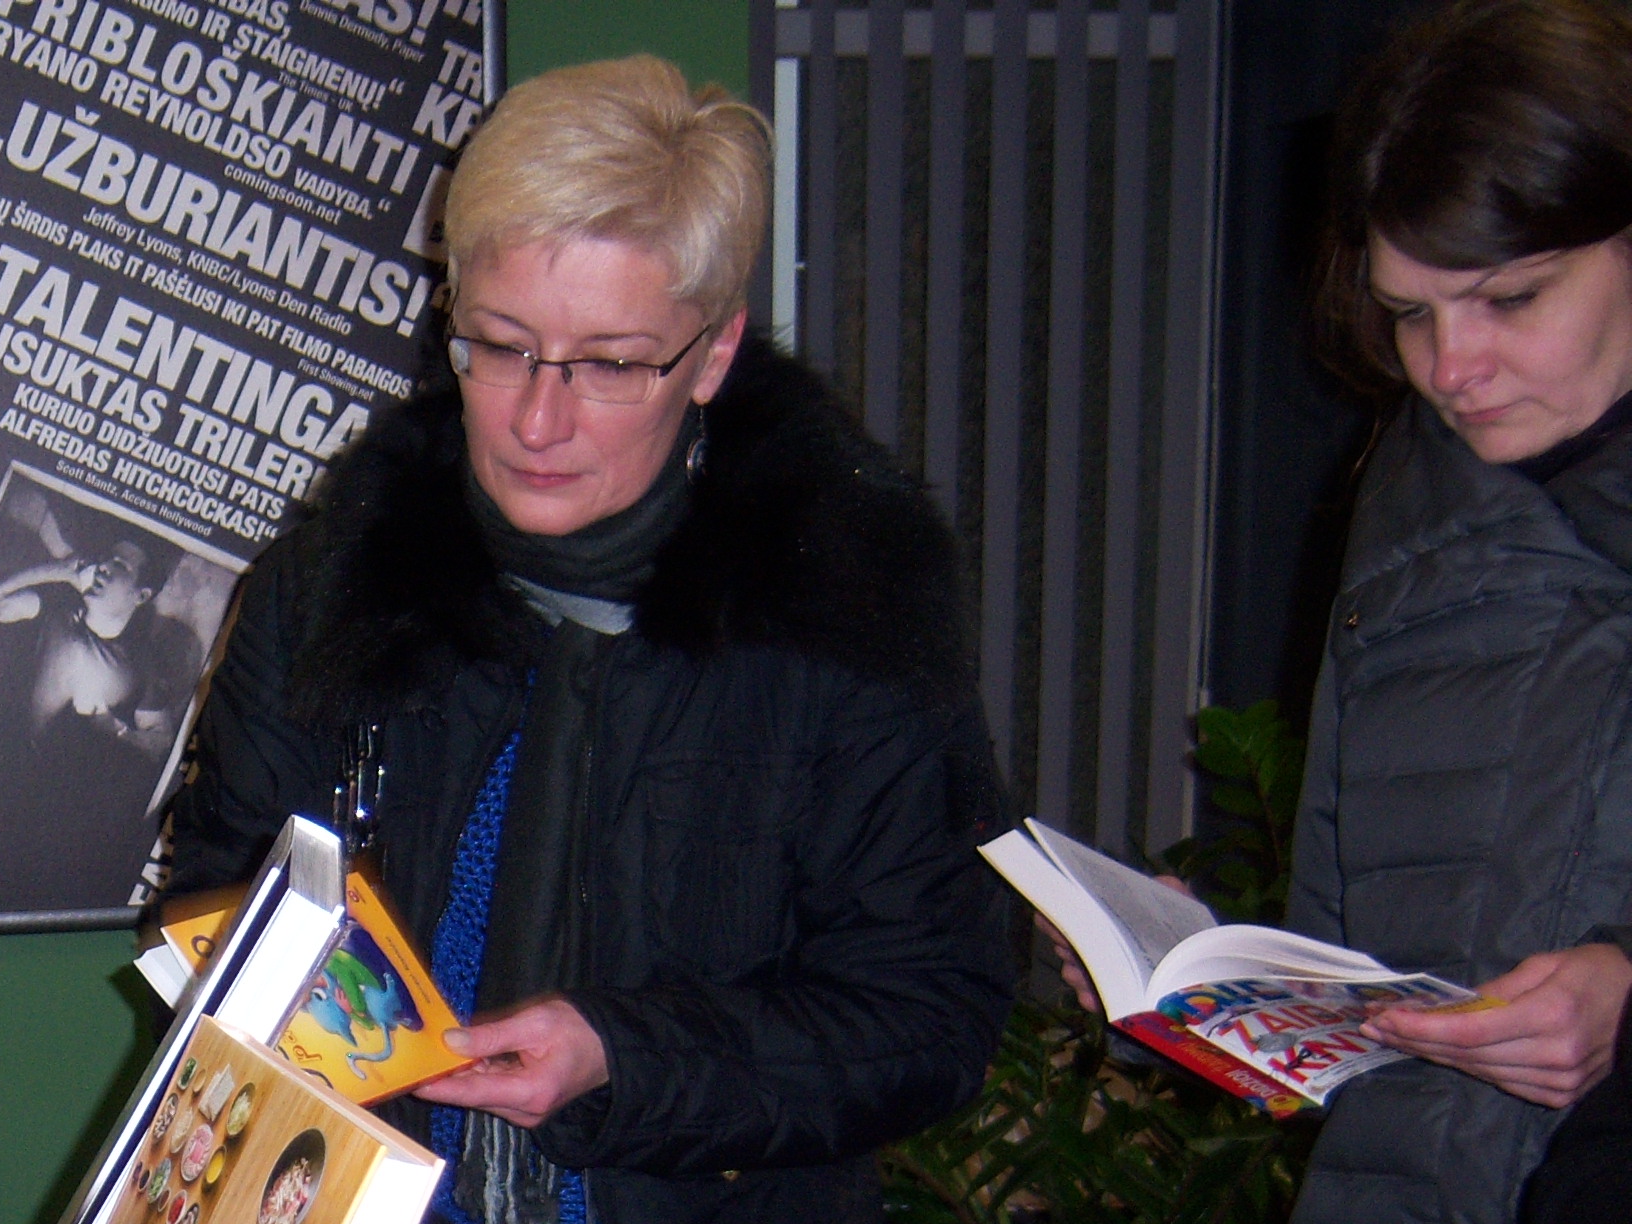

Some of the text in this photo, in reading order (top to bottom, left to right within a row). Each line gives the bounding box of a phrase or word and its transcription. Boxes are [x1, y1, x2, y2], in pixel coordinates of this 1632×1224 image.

[200, 8, 232, 43] IR
[391, 38, 425, 63] Paper
[277, 70, 296, 89] The
[99, 69, 291, 179] REYNOLDSO
[223, 162, 343, 226] comingsoon.net
[11, 200, 68, 246] ŠIRDIS
[68, 229, 124, 271] PLAKS
[123, 255, 143, 278] IT
[141, 263, 223, 315] PAŠĖLUSI
[222, 298, 246, 327] IKI
[245, 309, 282, 341] PAT
[279, 324, 334, 365] FILMO
[83, 206, 353, 336] Jeffrey Lyons, KNBC/Lyons Den Radio
[13, 381, 96, 436] KURIUO
[228, 477, 286, 521] PATS
[55, 458, 85, 481] Scott
[158, 505, 213, 539] Hollywood
